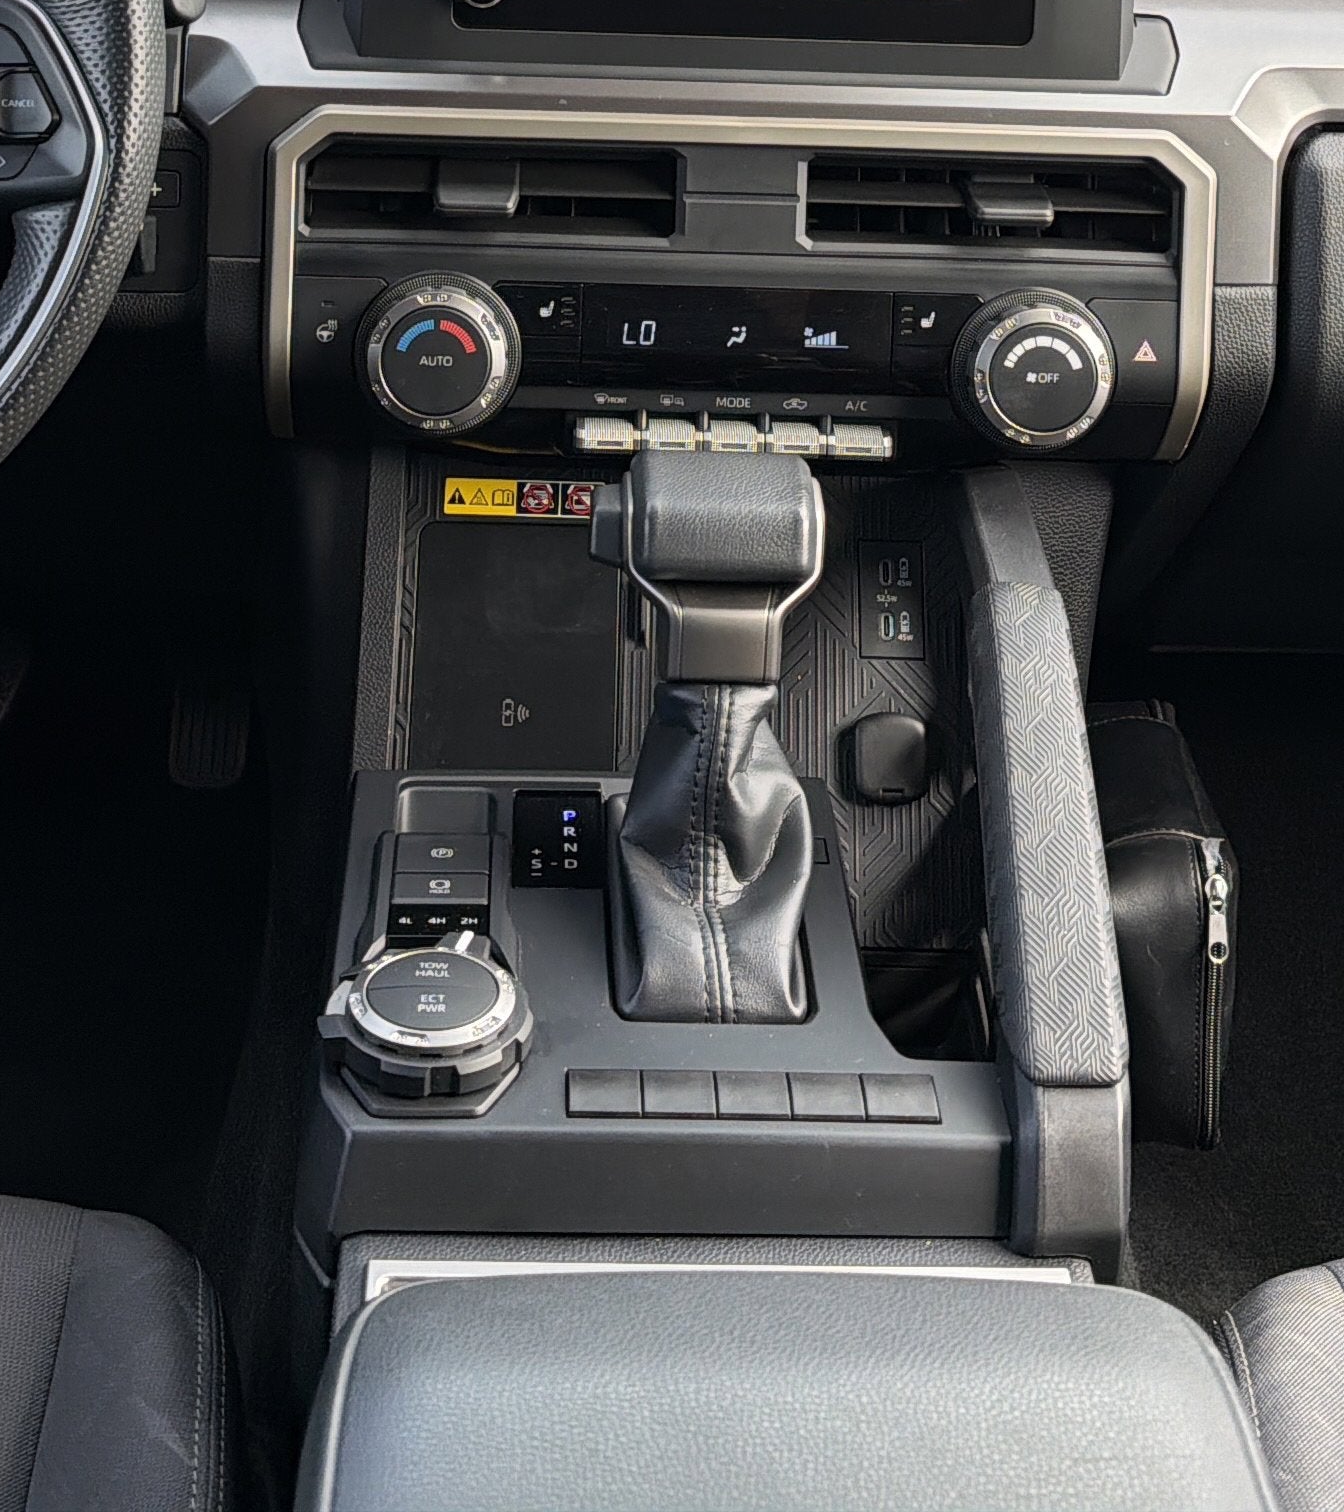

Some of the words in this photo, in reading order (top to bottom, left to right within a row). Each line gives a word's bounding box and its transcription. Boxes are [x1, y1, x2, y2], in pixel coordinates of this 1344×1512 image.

[1, 98, 35, 108] CANCEL
[622, 320, 656, 346] LO
[419, 355, 453, 367] AUTO
[1038, 372, 1060, 384] OFF
[607, 396, 628, 404] FRONT
[715, 396, 751, 408] MODE
[845, 399, 868, 412] A/C
[563, 810, 577, 821] P
[564, 827, 576, 837] R
[564, 843, 578, 853] N
[531, 859, 542, 869] S
[564, 859, 578, 869] D
[398, 916, 413, 925] 4L
[427, 917, 446, 926] 4H
[460, 917, 478, 925] 2H
[419, 961, 449, 969] TOW
[415, 969, 451, 978] HAUL
[420, 994, 446, 1003] ECT
[417, 1004, 446, 1013] PWR
